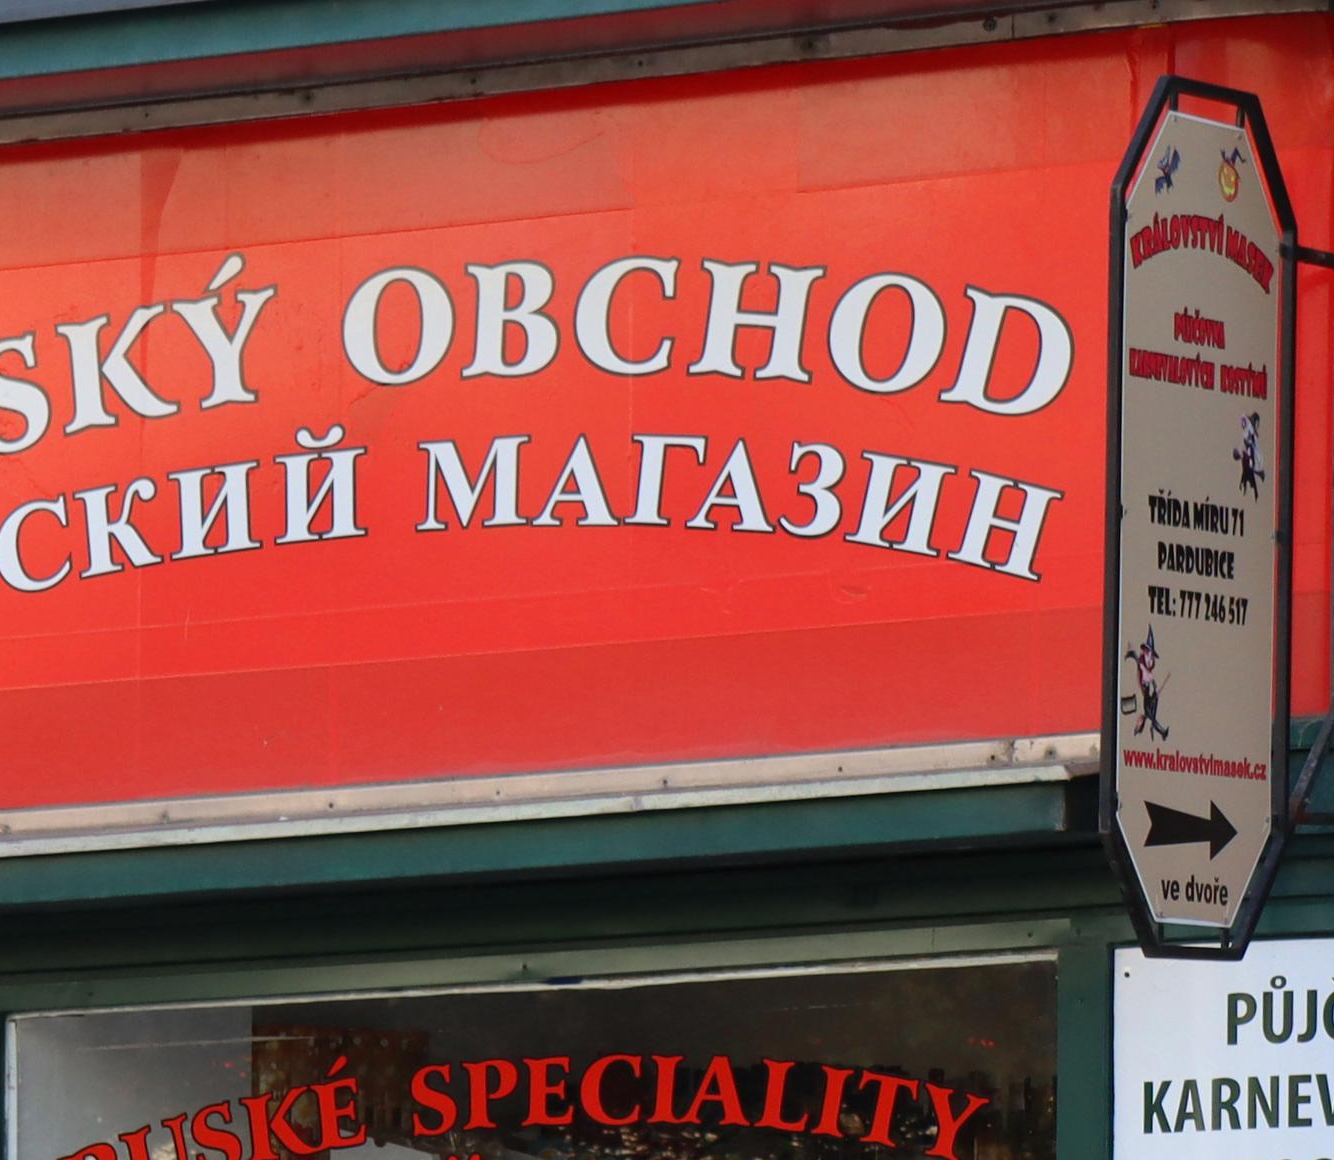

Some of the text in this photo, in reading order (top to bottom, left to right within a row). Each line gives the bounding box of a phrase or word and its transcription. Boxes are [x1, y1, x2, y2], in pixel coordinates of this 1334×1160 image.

[1129, 211, 1274, 295] KRÁLOVSTVÍ MASEK
[341, 255, 1075, 417] OBCHOD
[416, 432, 1065, 583] МАГАЗИН
[1148, 488, 1245, 537] TŘÍDA MÍRU 71
[1157, 541, 1235, 580] PARDUBICE
[1148, 585, 1249, 626] TEL: 777 246 517
[1123, 748, 1267, 780] www.kralovstvimasek.cz
[1161, 874, 1229, 907] ve dvoře
